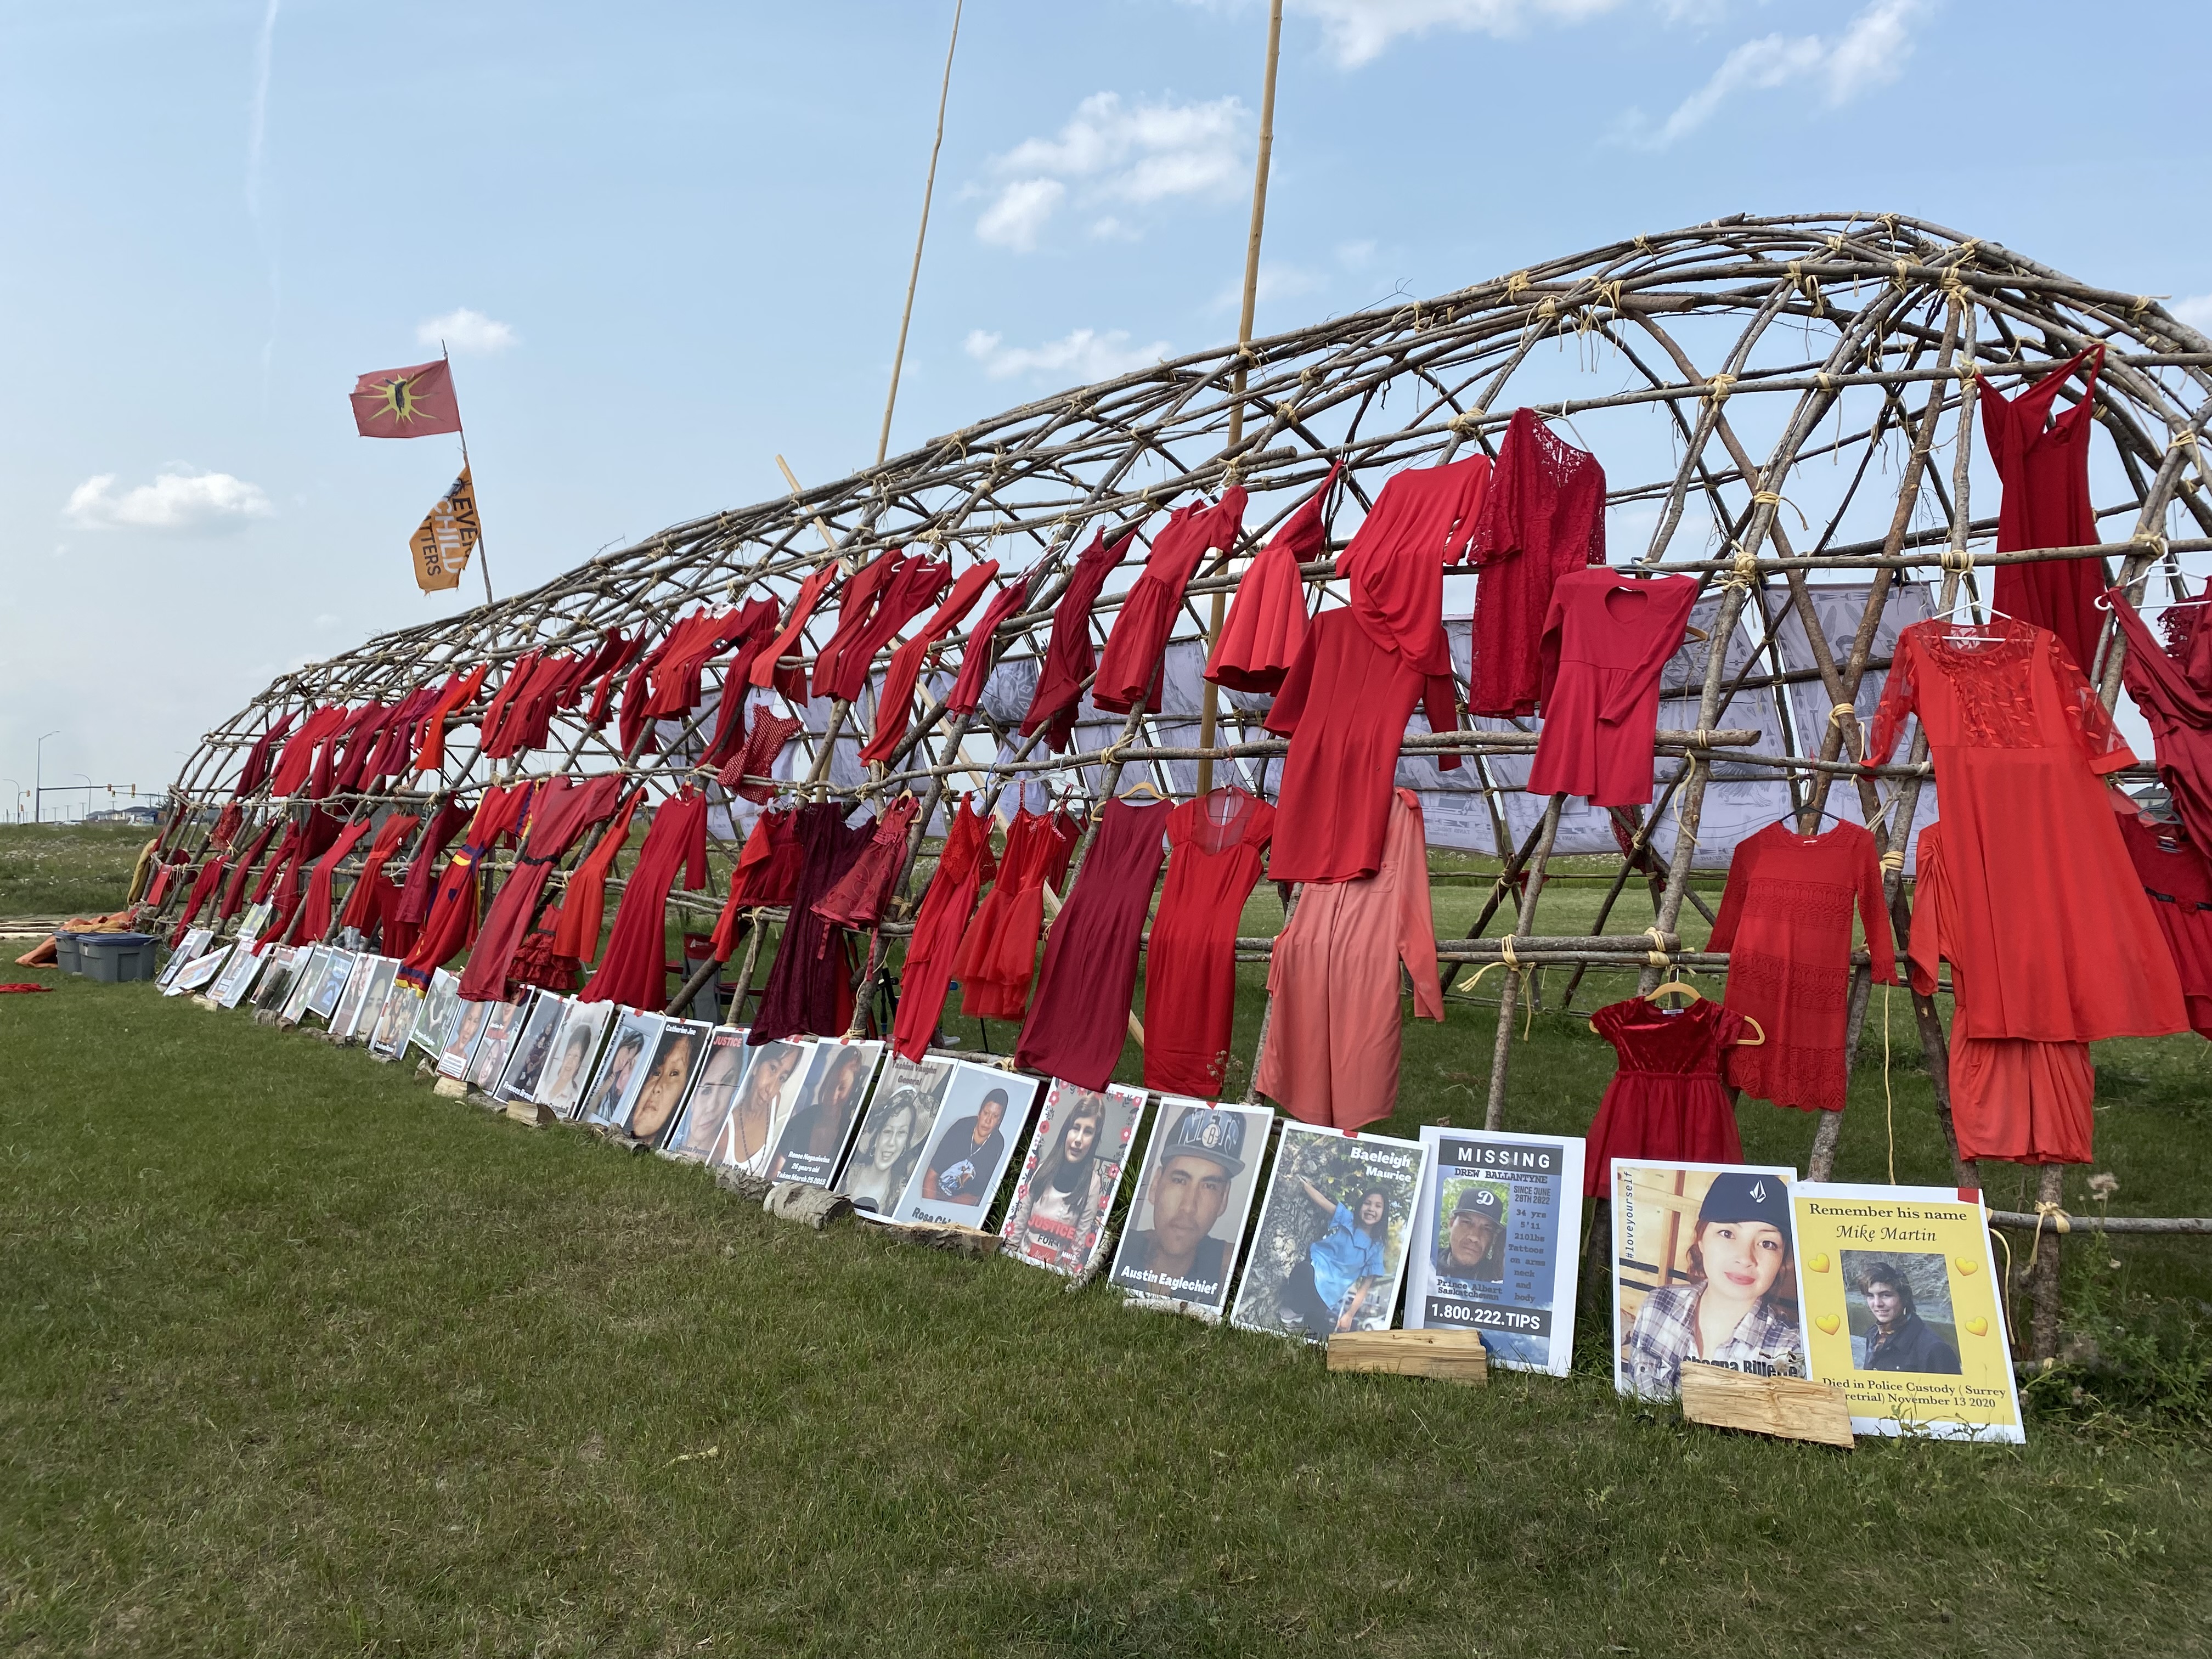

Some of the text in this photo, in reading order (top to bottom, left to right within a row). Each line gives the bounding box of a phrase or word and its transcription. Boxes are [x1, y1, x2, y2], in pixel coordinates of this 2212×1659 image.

[434, 500, 464, 573] CHILD
[713, 1036, 743, 1047] JUSTICE
[898, 1075, 922, 1086] General
[1350, 1147, 1411, 1169] Baeleigh
[1458, 1147, 1550, 1169] MISSING
[777, 1171, 791, 1180] Taken
[791, 1173, 807, 1182] March
[1365, 1166, 1412, 1183] Maurice
[1454, 1167, 1548, 1184] DREW BALLANTYNE
[1476, 1190, 1494, 1206] D
[1514, 1186, 1551, 1197] SINCE JUNE
[912, 1206, 933, 1222] Rosa
[1531, 1211, 1547, 1219] yrs
[1623, 1171, 1636, 1259] #loveyourself
[1809, 1203, 1967, 1221] Remember his name
[1028, 1214, 1076, 1239] JUSTICE
[1520, 1221, 1541, 1229] 5'11
[1836, 1224, 1937, 1242] Mike Martin
[1514, 1233, 1545, 1242] 210lbs
[1508, 1244, 1544, 1254] Tattoos
[1121, 1265, 1218, 1295] Austin Eaglechief
[1437, 1279, 1503, 1295] Prince Albert
[1438, 1287, 1499, 1301] Saskatchewan
[1514, 1293, 1536, 1304] body
[1431, 1303, 1541, 1330] 1.800.222.TIPS
[1822, 1378, 1850, 1388] Died
[1853, 1379, 1865, 1389] in
[1867, 1380, 1903, 1391] Police
[1906, 1382, 1955, 1395] Custody
[1965, 1385, 2006, 1398] Surrey
[1888, 1393, 1950, 1406] November
[1954, 1396, 1967, 1407] 13
[1970, 1397, 1996, 1408] 2020
